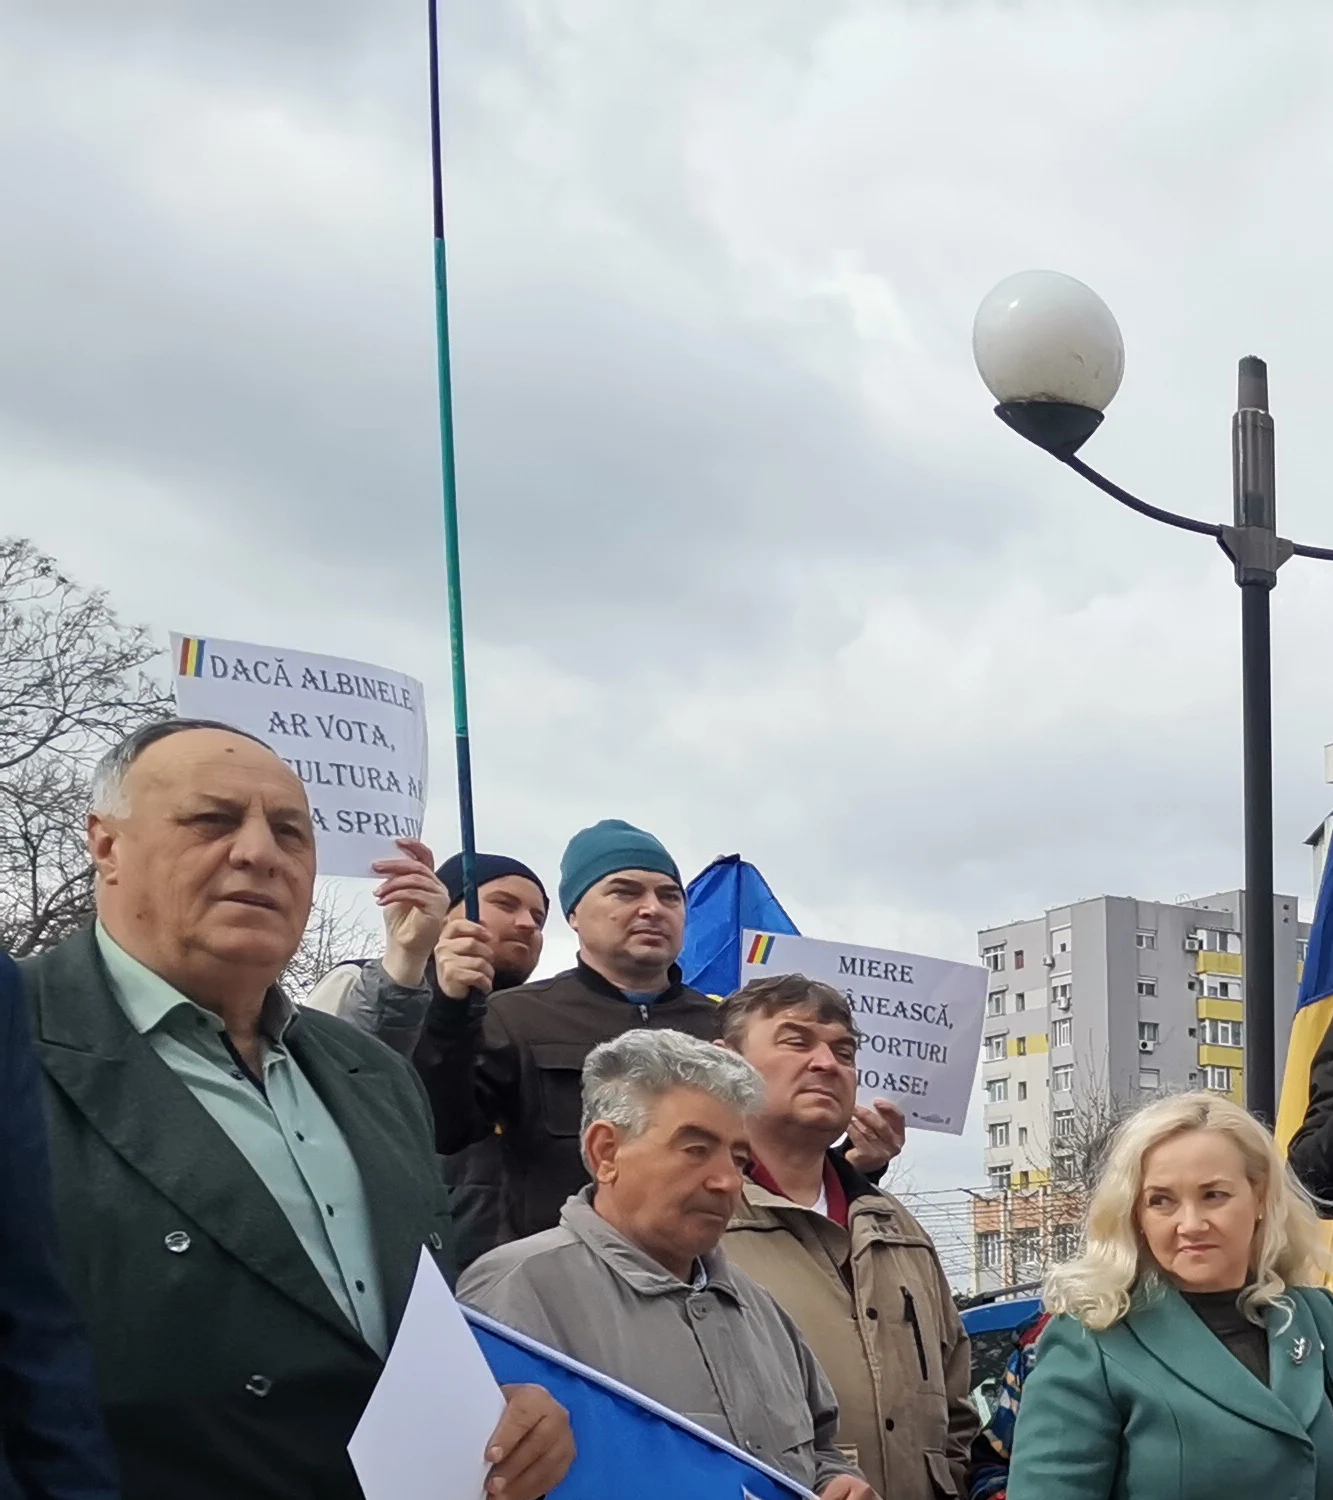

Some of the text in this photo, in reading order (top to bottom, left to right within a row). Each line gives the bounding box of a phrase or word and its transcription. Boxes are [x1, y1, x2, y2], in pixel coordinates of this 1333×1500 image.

[211, 654, 415, 711] DACĂ ALBINELE
[268, 711, 396, 752] AR VOTA,
[282, 758, 404, 794] ULTURA
[838, 956, 914, 984] MIERE
[857, 1033, 948, 1064] PORTURI
